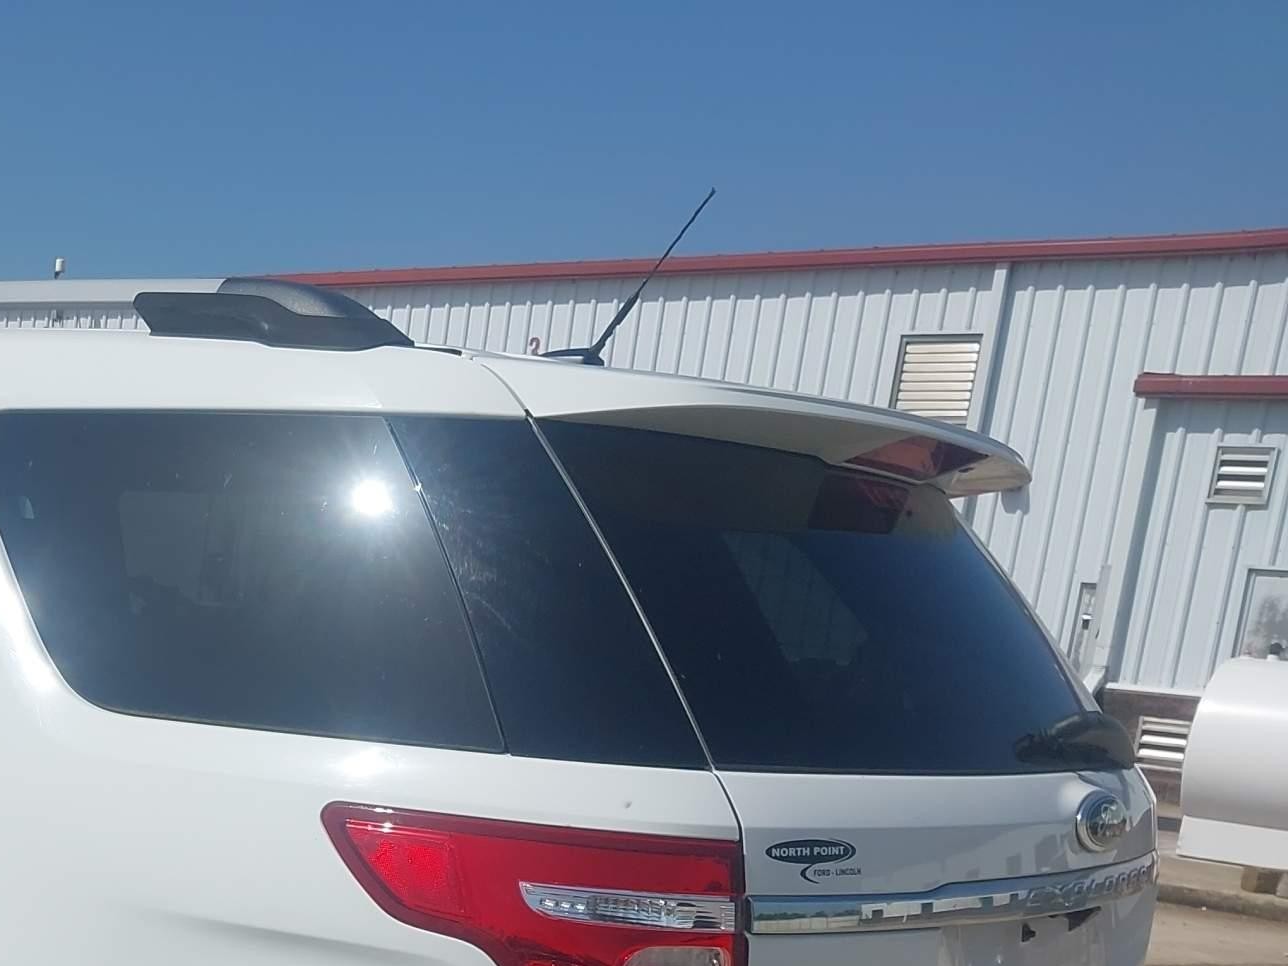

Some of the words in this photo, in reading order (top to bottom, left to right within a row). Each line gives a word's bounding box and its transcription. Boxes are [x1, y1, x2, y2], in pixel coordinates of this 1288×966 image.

[770, 846, 810, 858] NORTH
[813, 844, 846, 857] POINT
[813, 868, 831, 878] FORD
[836, 867, 862, 877] LINCOLN
